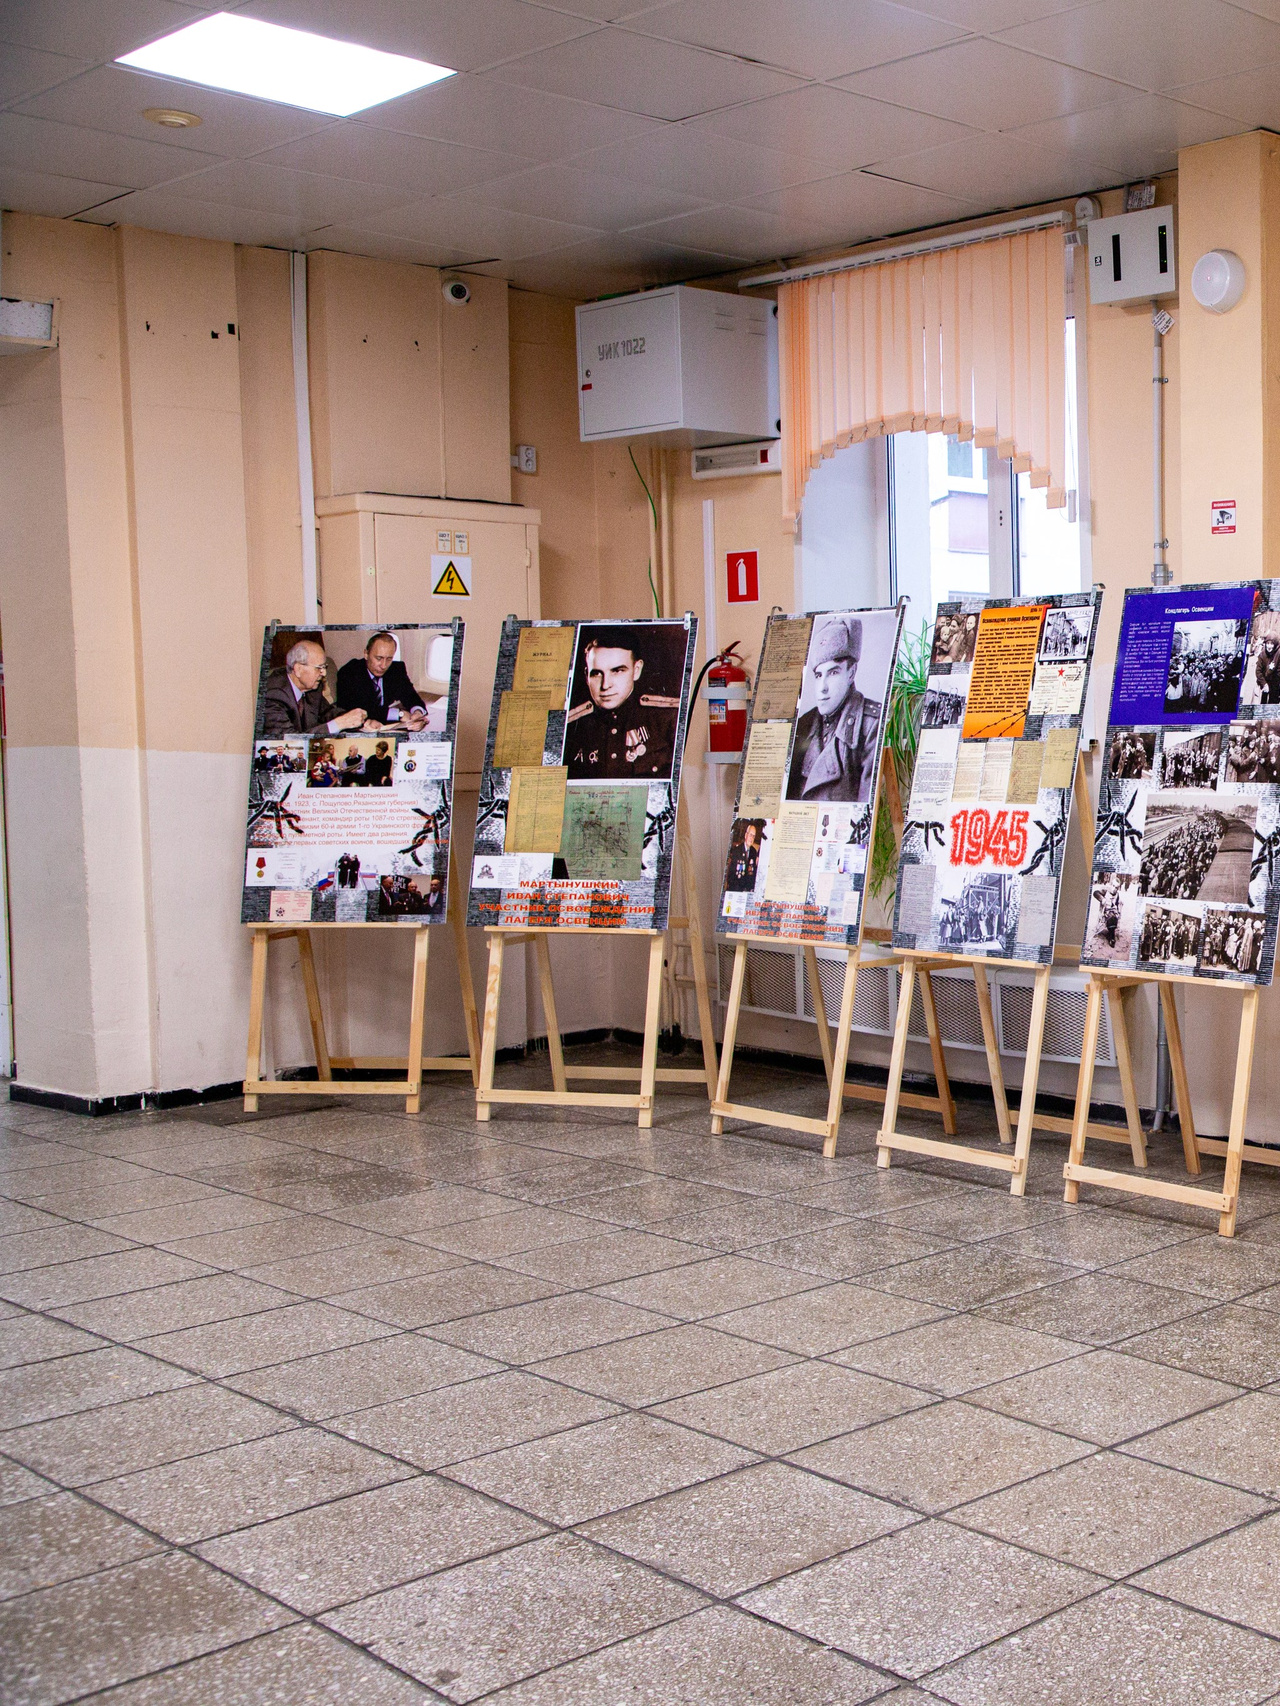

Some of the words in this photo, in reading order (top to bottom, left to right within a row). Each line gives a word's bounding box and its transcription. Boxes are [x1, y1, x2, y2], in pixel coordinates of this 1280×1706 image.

[598, 342, 620, 361] УИК
[621, 337, 646, 356] 1022
[950, 808, 1029, 866] 1945
[519, 880, 619, 890] МАРТЫНУШКИН
[545, 892, 630, 902] СТЕПАНОВИЧ
[478, 903, 545, 912] УЧАСТНИК
[548, 904, 655, 914] ОСВОБОЖДЕНИЯ
[754, 901, 820, 911] МАРТЫНУШКИН
[504, 916, 553, 924] ЛАГЕРЯ
[556, 917, 627, 926] ОСВЕНЦИМ
[770, 912, 828, 922] СТЕПАНОВИЧ
